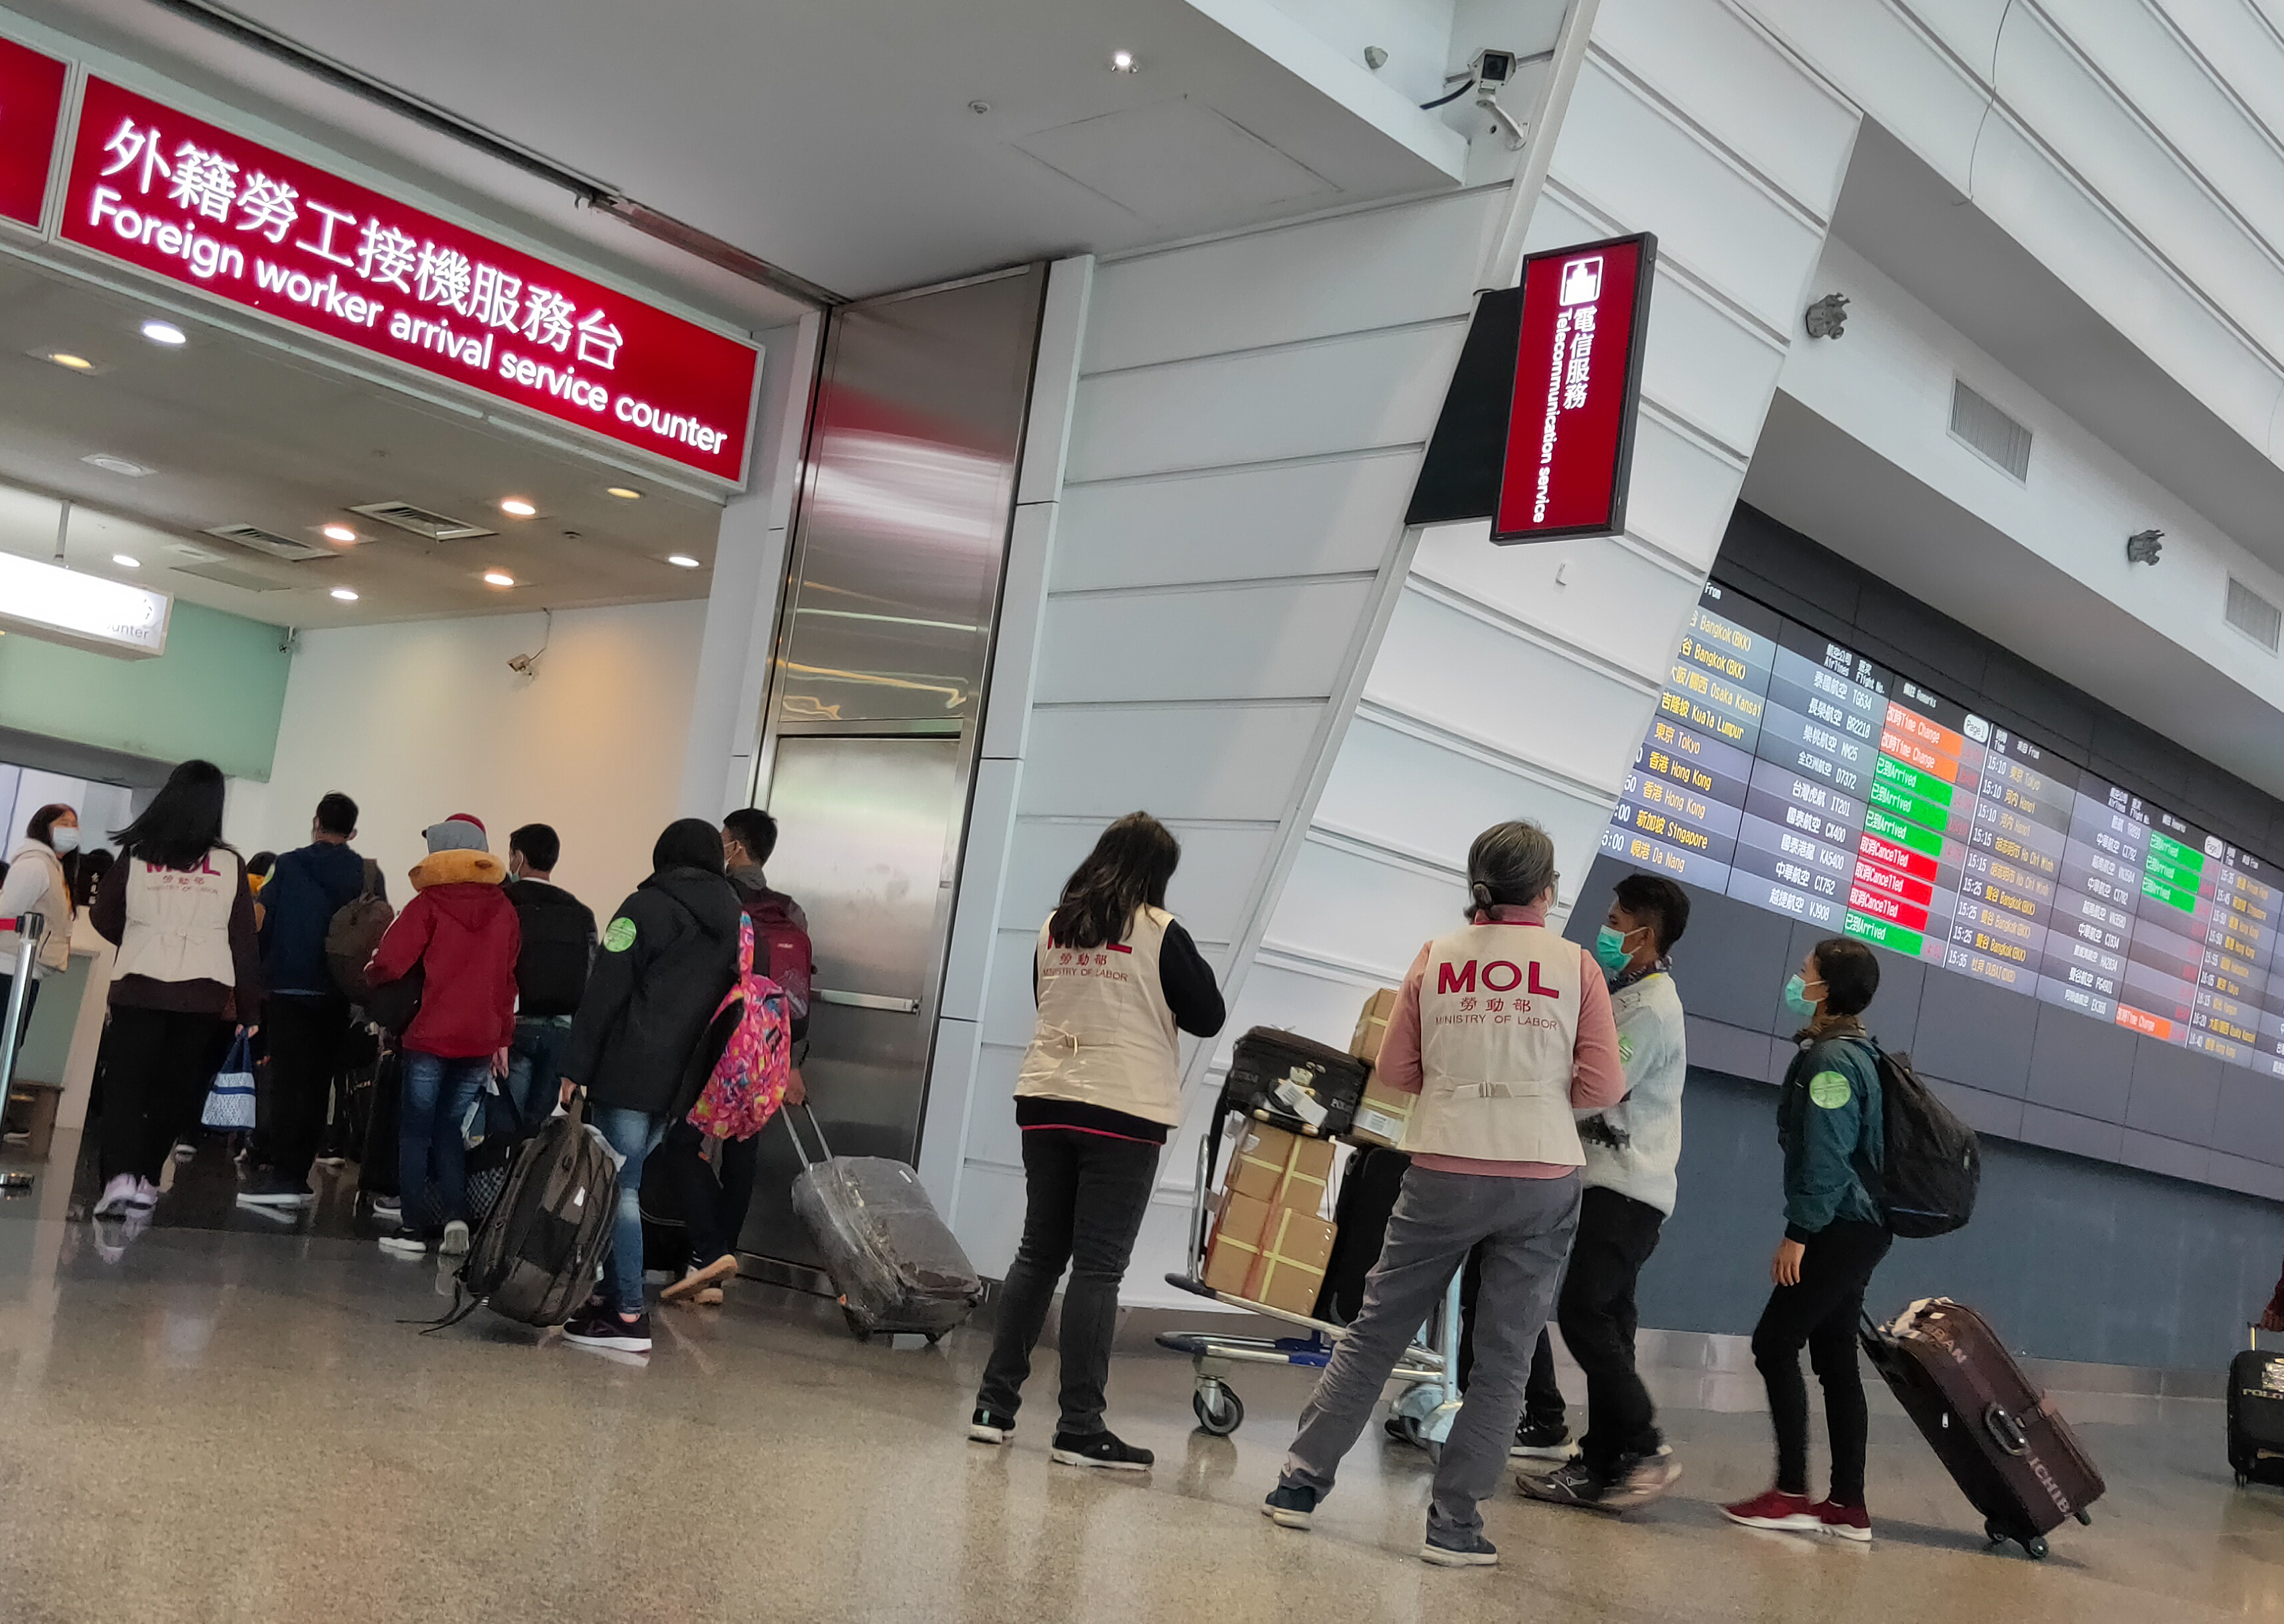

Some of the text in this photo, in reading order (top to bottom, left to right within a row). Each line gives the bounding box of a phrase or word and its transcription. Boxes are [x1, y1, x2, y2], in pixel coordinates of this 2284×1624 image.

[101, 118, 623, 370] 外籍勞工接機服務台
[89, 187, 728, 454] Foreign worker arrival service counter
[1562, 306, 1598, 409] 電信服務
[1533, 308, 1573, 523] Telecommunication service
[1704, 582, 1722, 600] From
[1824, 656, 1850, 677] Airlines
[1856, 671, 1875, 689] Flight
[1710, 682, 1733, 705] Osaka
[1735, 693, 1762, 718] Kansai
[1814, 671, 1848, 700] 泰國航空
[1853, 689, 1873, 711] TG634
[1662, 691, 1745, 740] 吉隆坡 Kuala Lumpur
[1808, 697, 1871, 738] 長榮航空 BR2218
[1654, 722, 1701, 754] 東京 Tokyo
[1918, 722, 1940, 744] Change
[1649, 751, 1670, 774] 香港
[1670, 760, 1690, 783] Hong
[1692, 768, 1712, 791] Kong
[1912, 747, 1935, 768] Change
[1987, 756, 2007, 775] 15:10
[1643, 781, 1664, 802] 香港
[1664, 789, 1684, 812] Hong
[1686, 797, 1706, 819] Kong
[1792, 779, 1851, 817] 台灣虎航 IT201
[1983, 779, 2001, 799] 15:10
[1978, 803, 1997, 823] 15:10
[1636, 809, 1666, 835] 新加坡
[1668, 821, 1708, 850] Singapore
[1825, 822, 1846, 843] CX400
[1819, 848, 1844, 870] KA5400
[1972, 827, 1993, 847] 15:15
[2021, 848, 2029, 862] Ho
[1652, 847, 1663, 864] Da
[1665, 852, 1686, 873] Nang
[1968, 853, 1988, 872] 15:15
[1775, 861, 1836, 895] 中華航空 CI752
[1962, 877, 1983, 896] 15:25
[1810, 901, 1830, 921] VJ908
[1958, 901, 1978, 920] 15:25
[1953, 925, 1973, 944] 15:25
[1948, 949, 1968, 967] 15:35
[1081, 968, 1093, 977] OF
[1095, 969, 1128, 982] LABOR
[1437, 959, 1560, 999] MOL
[1435, 1014, 1558, 1030] MINISTRY OF LABOR
